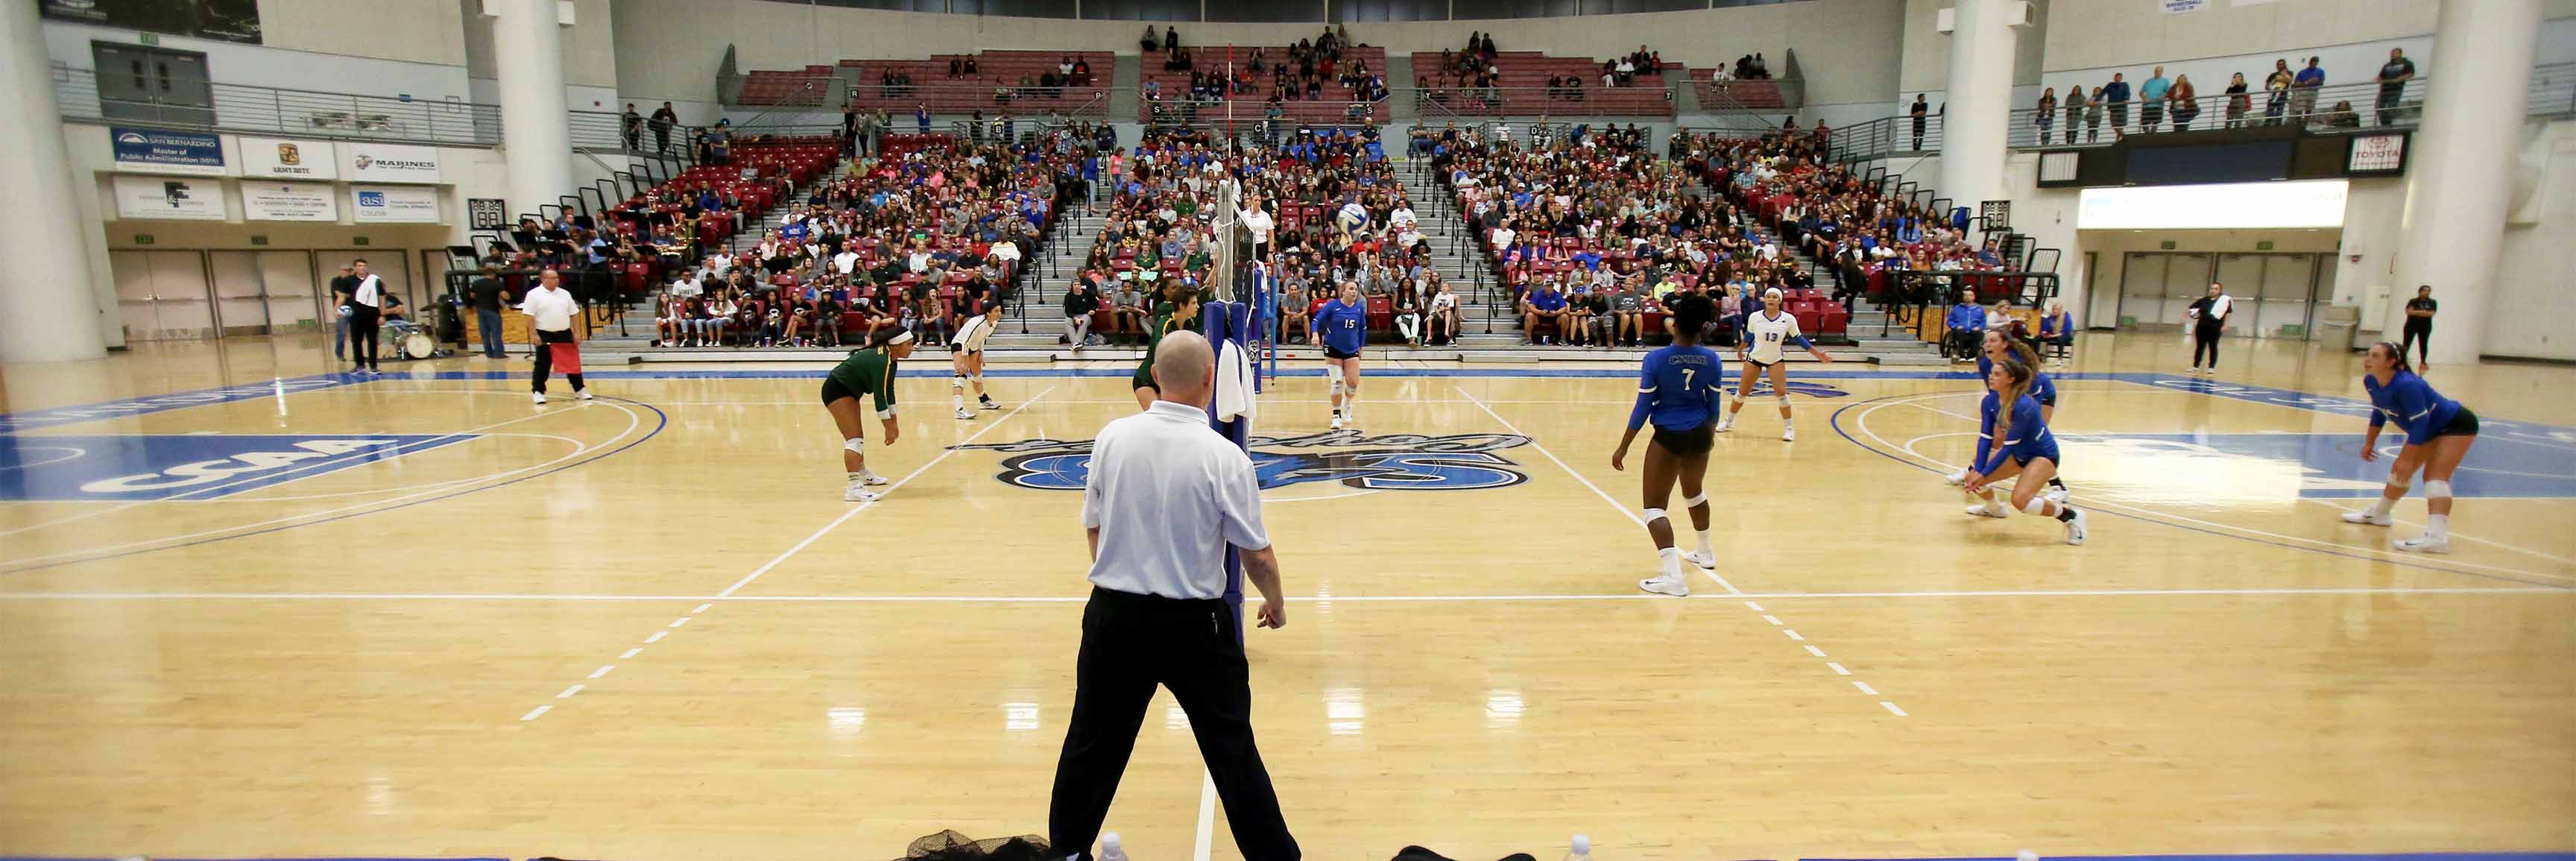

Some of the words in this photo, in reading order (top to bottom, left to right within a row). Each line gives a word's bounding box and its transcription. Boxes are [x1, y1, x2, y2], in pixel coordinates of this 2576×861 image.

[167, 139, 215, 148] BERNARDINO
[145, 154, 198, 163] Administration
[2355, 150, 2399, 159] TOYOTA
[376, 160, 435, 168] MARINES
[362, 194, 384, 206] asi
[1345, 319, 1355, 329] 15
[1765, 332, 1778, 342] 13
[1682, 368, 1695, 391] 7
